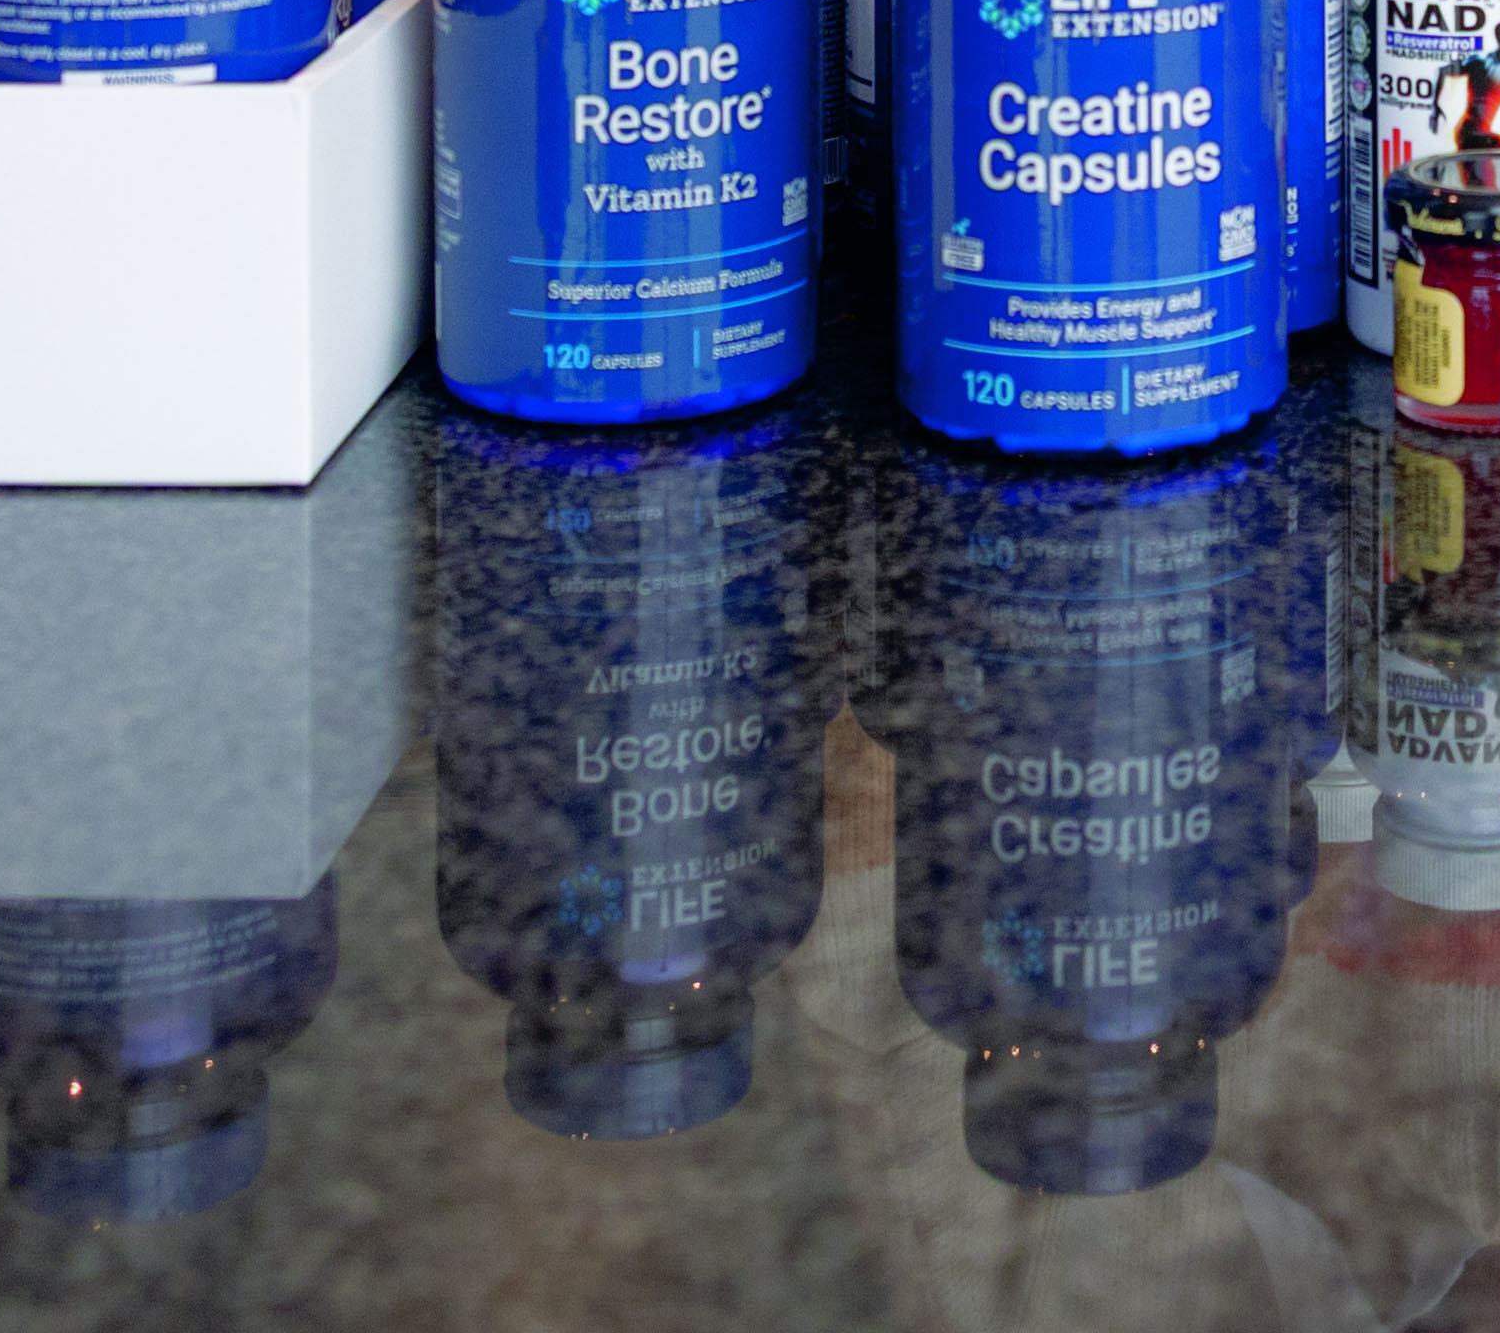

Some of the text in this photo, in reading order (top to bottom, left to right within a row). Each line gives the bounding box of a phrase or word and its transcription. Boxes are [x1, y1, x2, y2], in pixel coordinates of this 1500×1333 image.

[1051, 4, 1220, 38] EXTENSION
[1386, 0, 1487, 33] NAD
[609, 39, 739, 90] Bone
[1380, 74, 1433, 99] 300
[988, 80, 1213, 136] Creatine
[646, 145, 706, 172] with
[979, 135, 1222, 207] Capsules
[583, 172, 757, 214] Vitamin K2
[548, 260, 784, 304] Superior Calcium Formula
[1007, 287, 1202, 320] Provides Energy and
[712, 329, 786, 360] SUPPLEMENT
[989, 317, 1062, 347] Healthy
[1064, 320, 1138, 344] Muscle
[543, 343, 664, 370] 120 CAPSULES
[962, 369, 1116, 411] 120 CAPSULES
[1134, 364, 1206, 389] DIETARY
[1134, 371, 1241, 408] SUPPLEMENT
